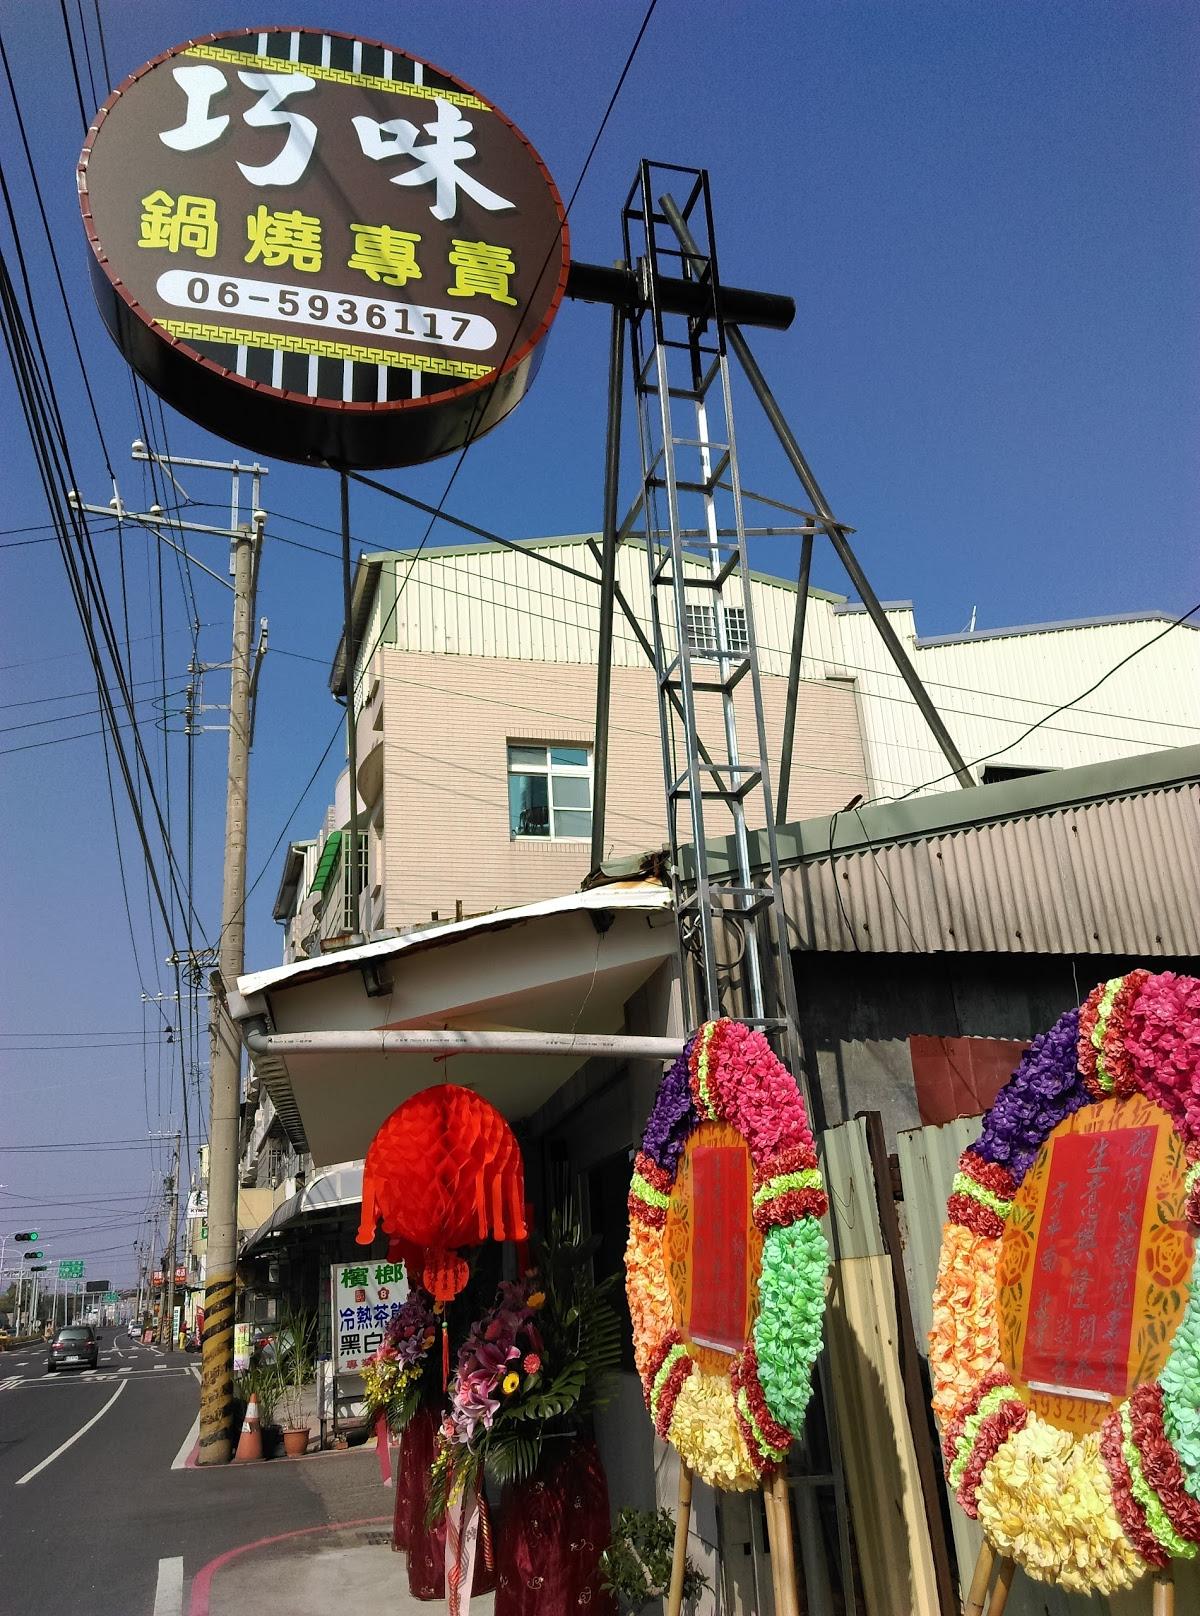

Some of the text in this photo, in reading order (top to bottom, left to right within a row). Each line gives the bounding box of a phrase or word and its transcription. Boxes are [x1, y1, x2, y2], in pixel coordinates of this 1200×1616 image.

[159, 65, 517, 221] 巧味
[137, 190, 518, 306] 鍋燒專賣
[186, 277, 472, 343] 06-5936117
[341, 1263, 403, 1288] 檳榔
